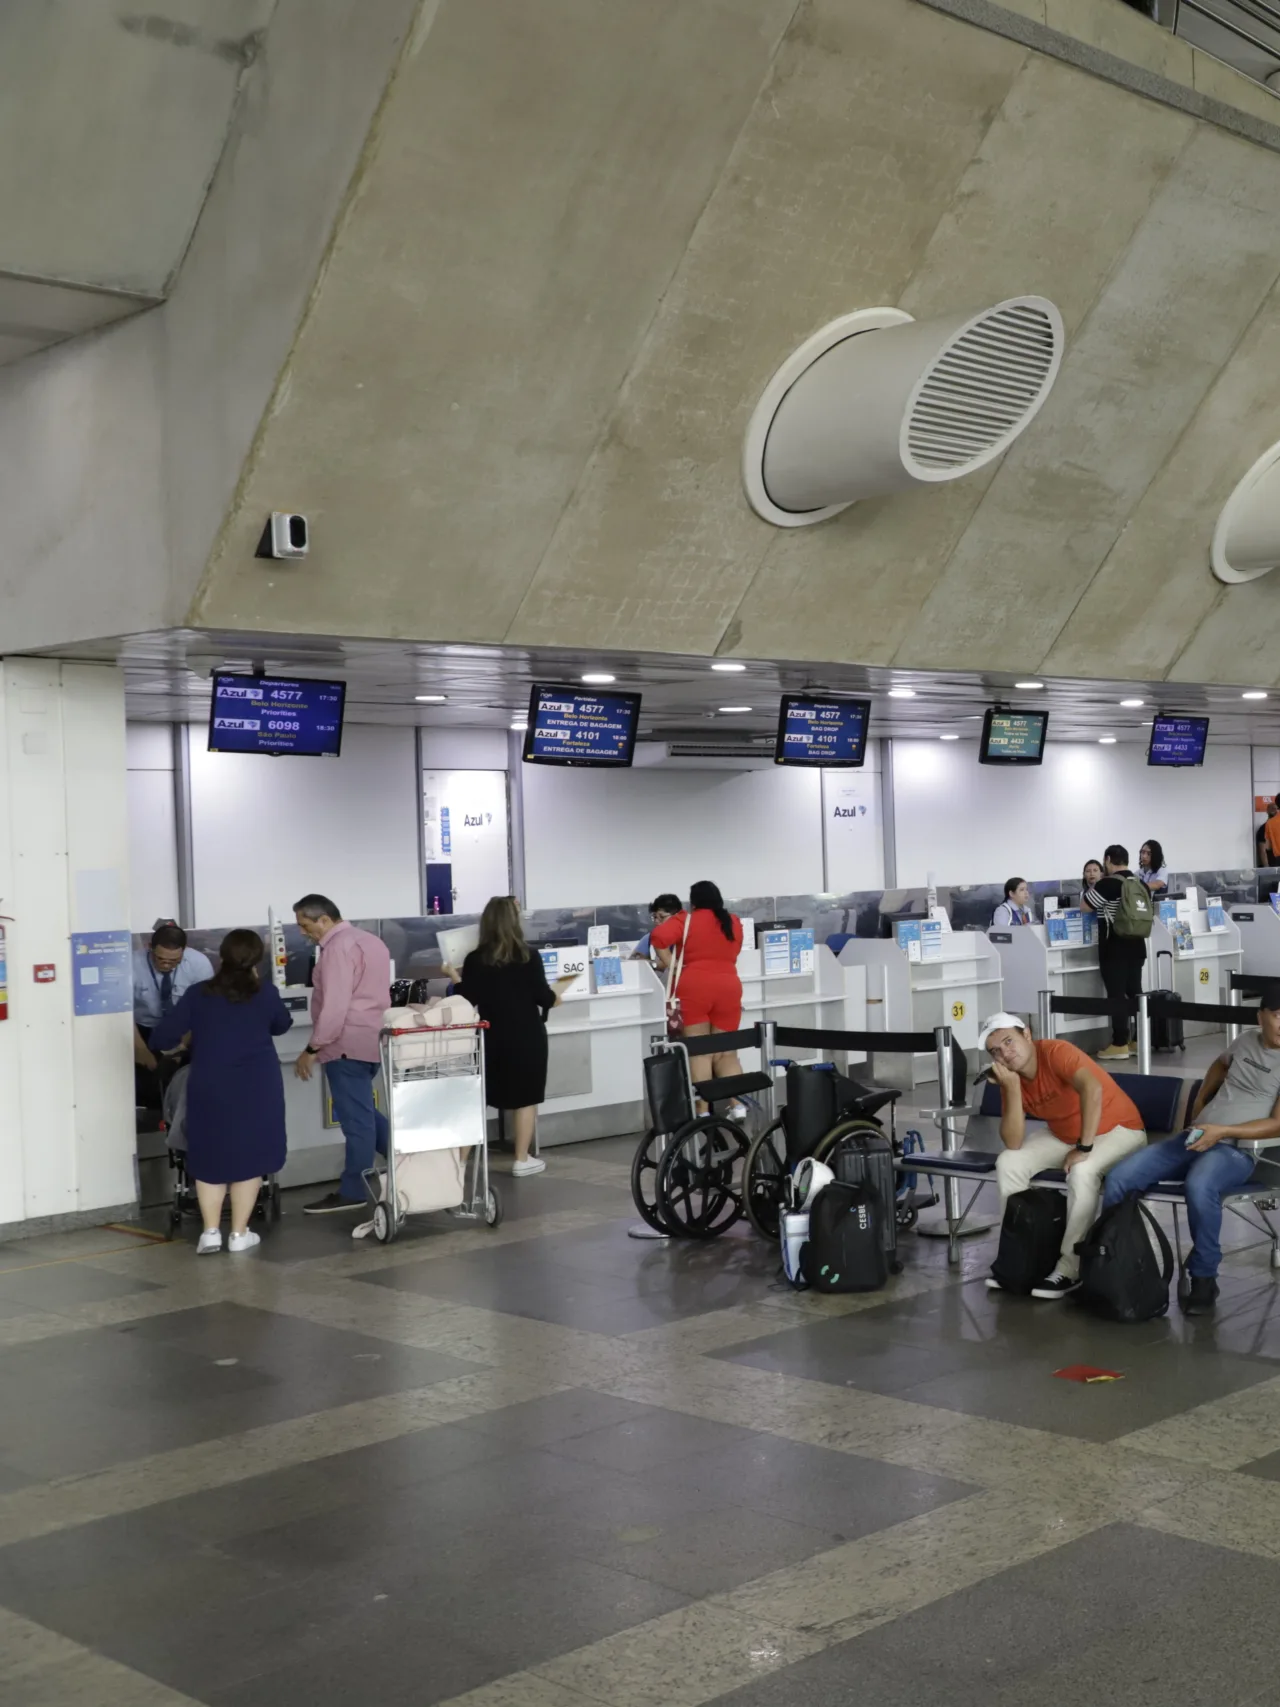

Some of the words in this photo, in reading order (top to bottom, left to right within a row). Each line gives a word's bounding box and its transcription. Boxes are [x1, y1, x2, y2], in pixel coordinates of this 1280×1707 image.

[260, 680, 299, 688] Departures
[220, 689, 247, 698] Azul
[270, 690, 303, 700] 4577
[271, 701, 308, 709] Horizonte
[541, 703, 562, 711] Azul
[579, 704, 604, 713] 4577
[261, 709, 297, 717] Priorities
[820, 711, 840, 719] 4577
[217, 720, 245, 729] Azul
[268, 720, 300, 731] 6098
[537, 730, 558, 738] Azul
[576, 731, 600, 740] 4101
[817, 735, 837, 743] 4101
[834, 806, 856, 817] Azul
[463, 814, 483, 827] Azul
[563, 962, 585, 974] SAC
[1200, 971, 1209, 981] 29
[952, 1005, 964, 1017] 31
[858, 1204, 867, 1230] CESBE
